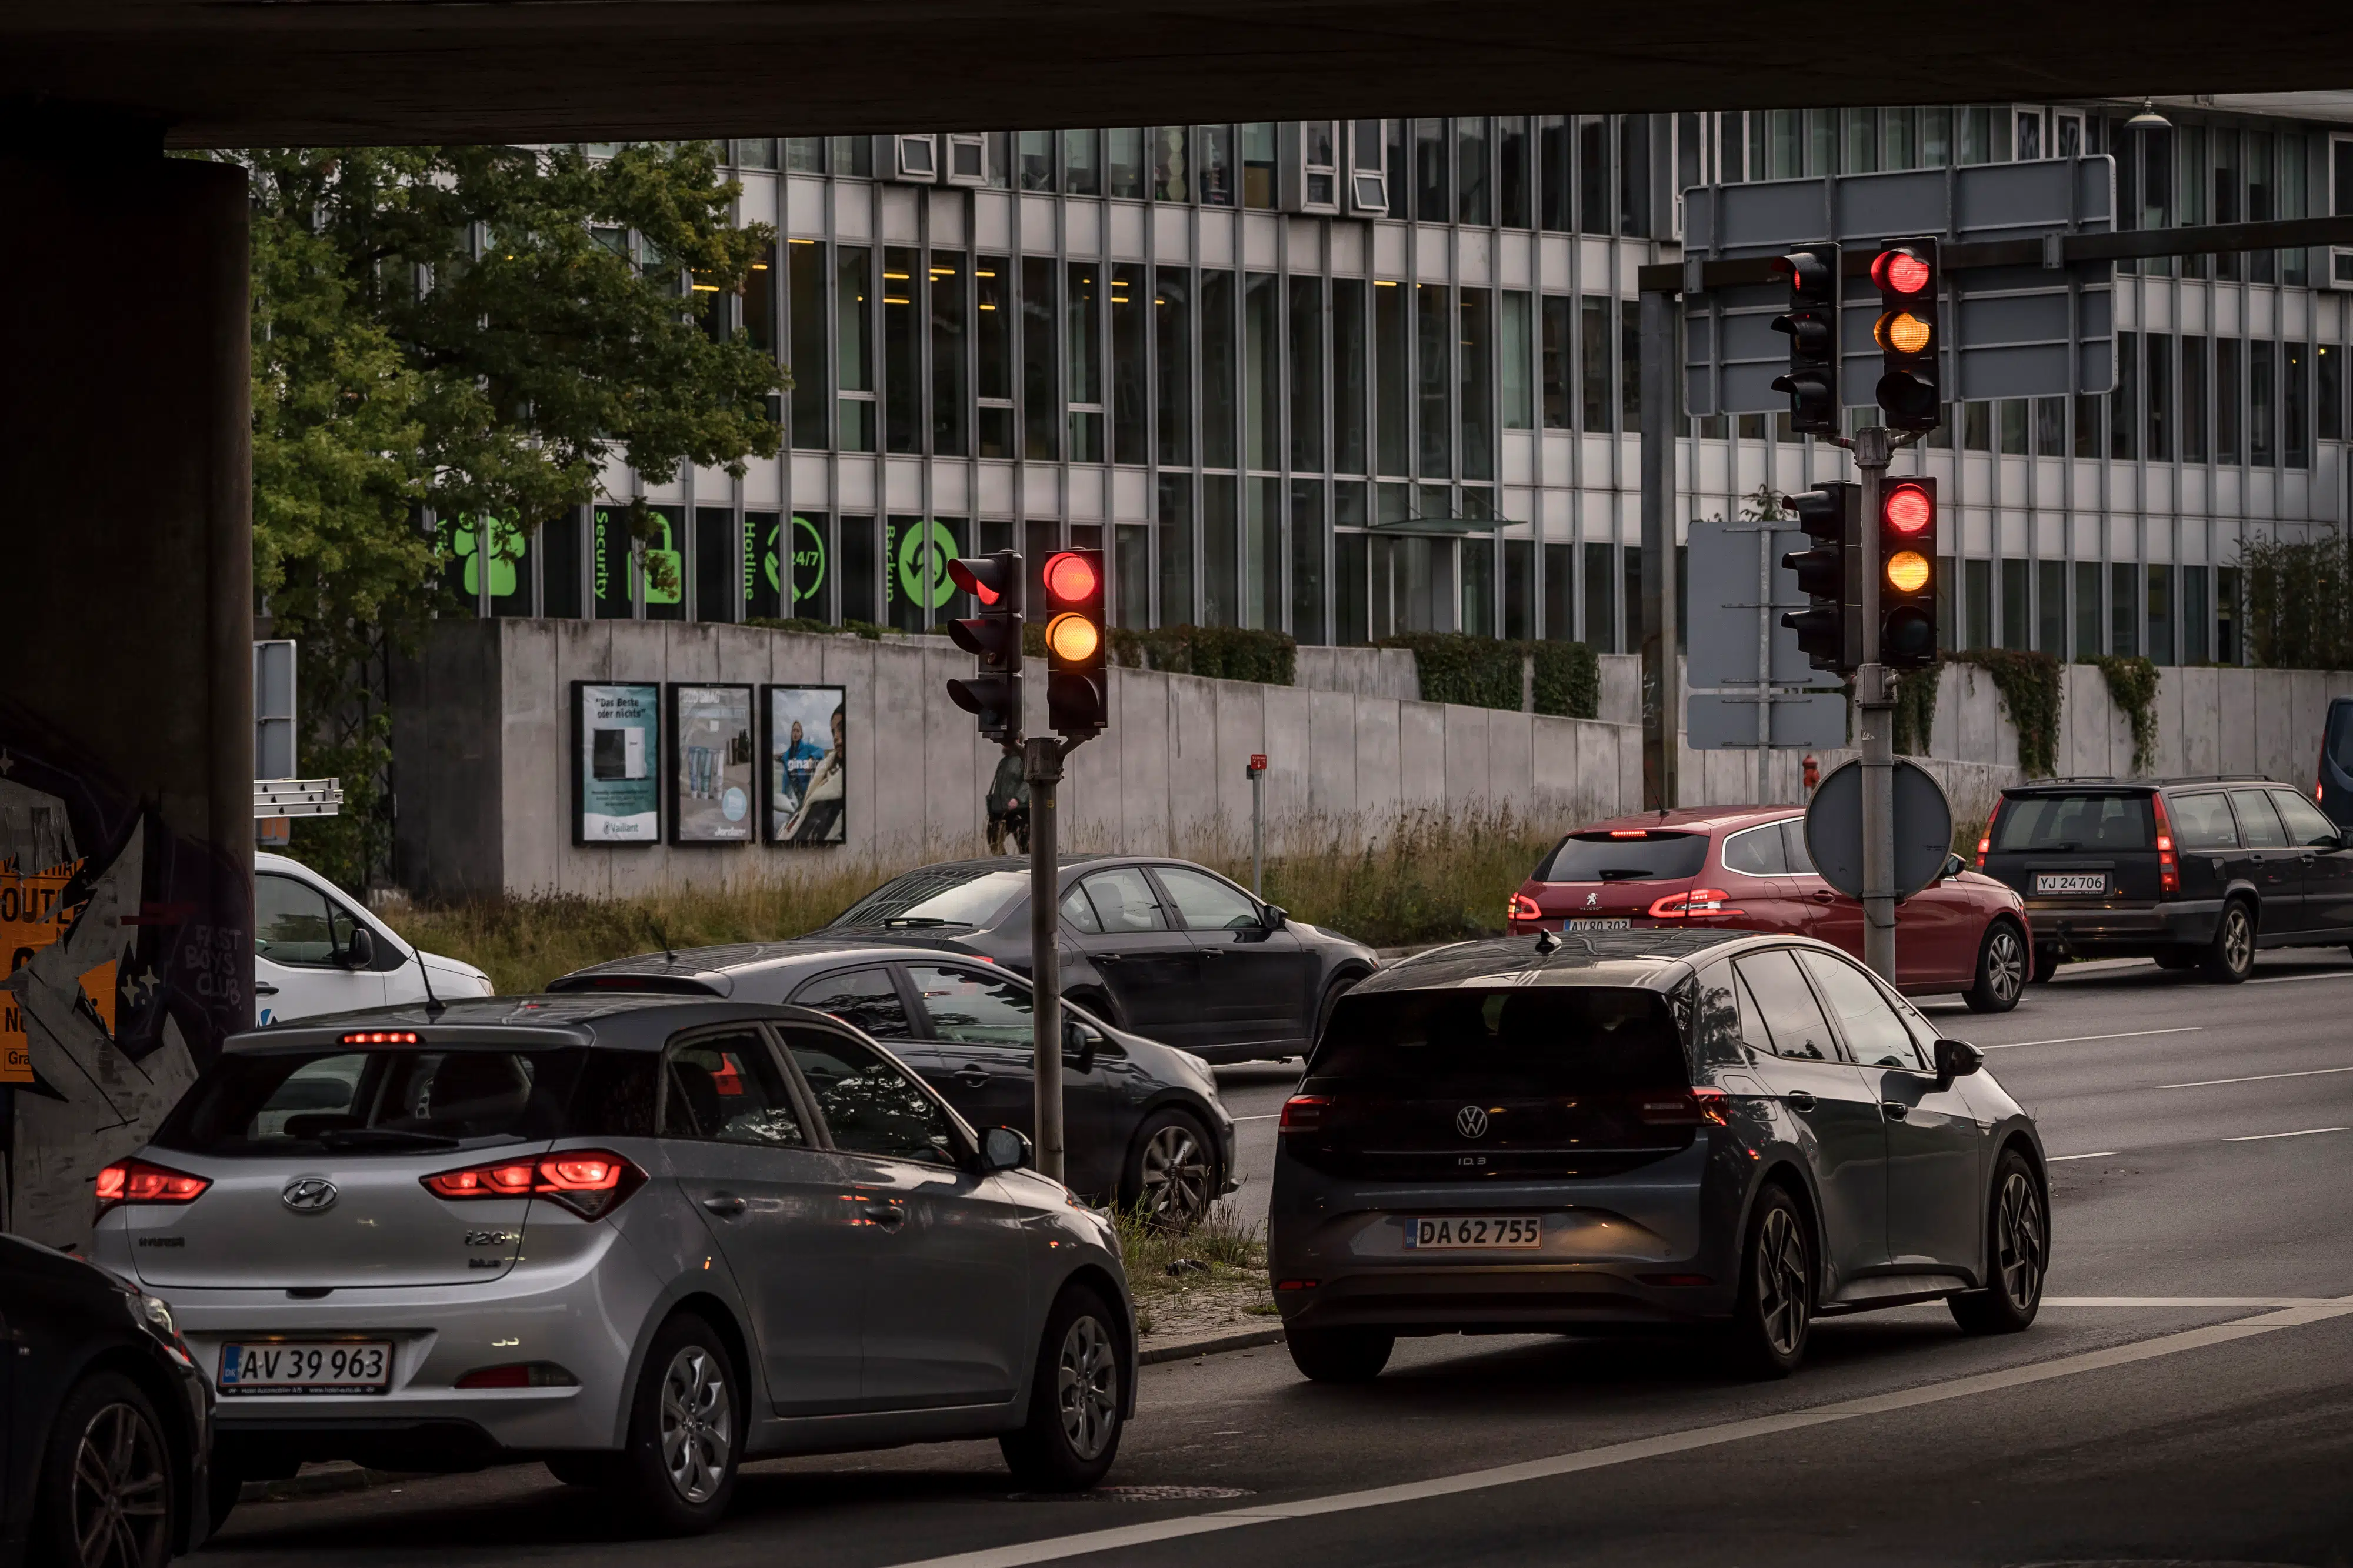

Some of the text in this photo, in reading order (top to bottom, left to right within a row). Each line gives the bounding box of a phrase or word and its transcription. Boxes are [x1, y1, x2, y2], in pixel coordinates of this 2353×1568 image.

[594, 511, 609, 600] Security
[745, 522, 757, 600] Hotline
[598, 708, 613, 718] oder
[617, 698, 639, 707] Beste
[611, 823, 639, 833] Vaillant
[2040, 877, 2056, 889] YJ
[195, 924, 242, 951] FAST
[1571, 920, 1587, 931] AV
[184, 943, 236, 976] BOYS
[1419, 1221, 1452, 1244] DA
[1458, 1220, 1488, 1243] 62
[1494, 1220, 1538, 1243] 755
[224, 1349, 384, 1379] DK AV 39 963
